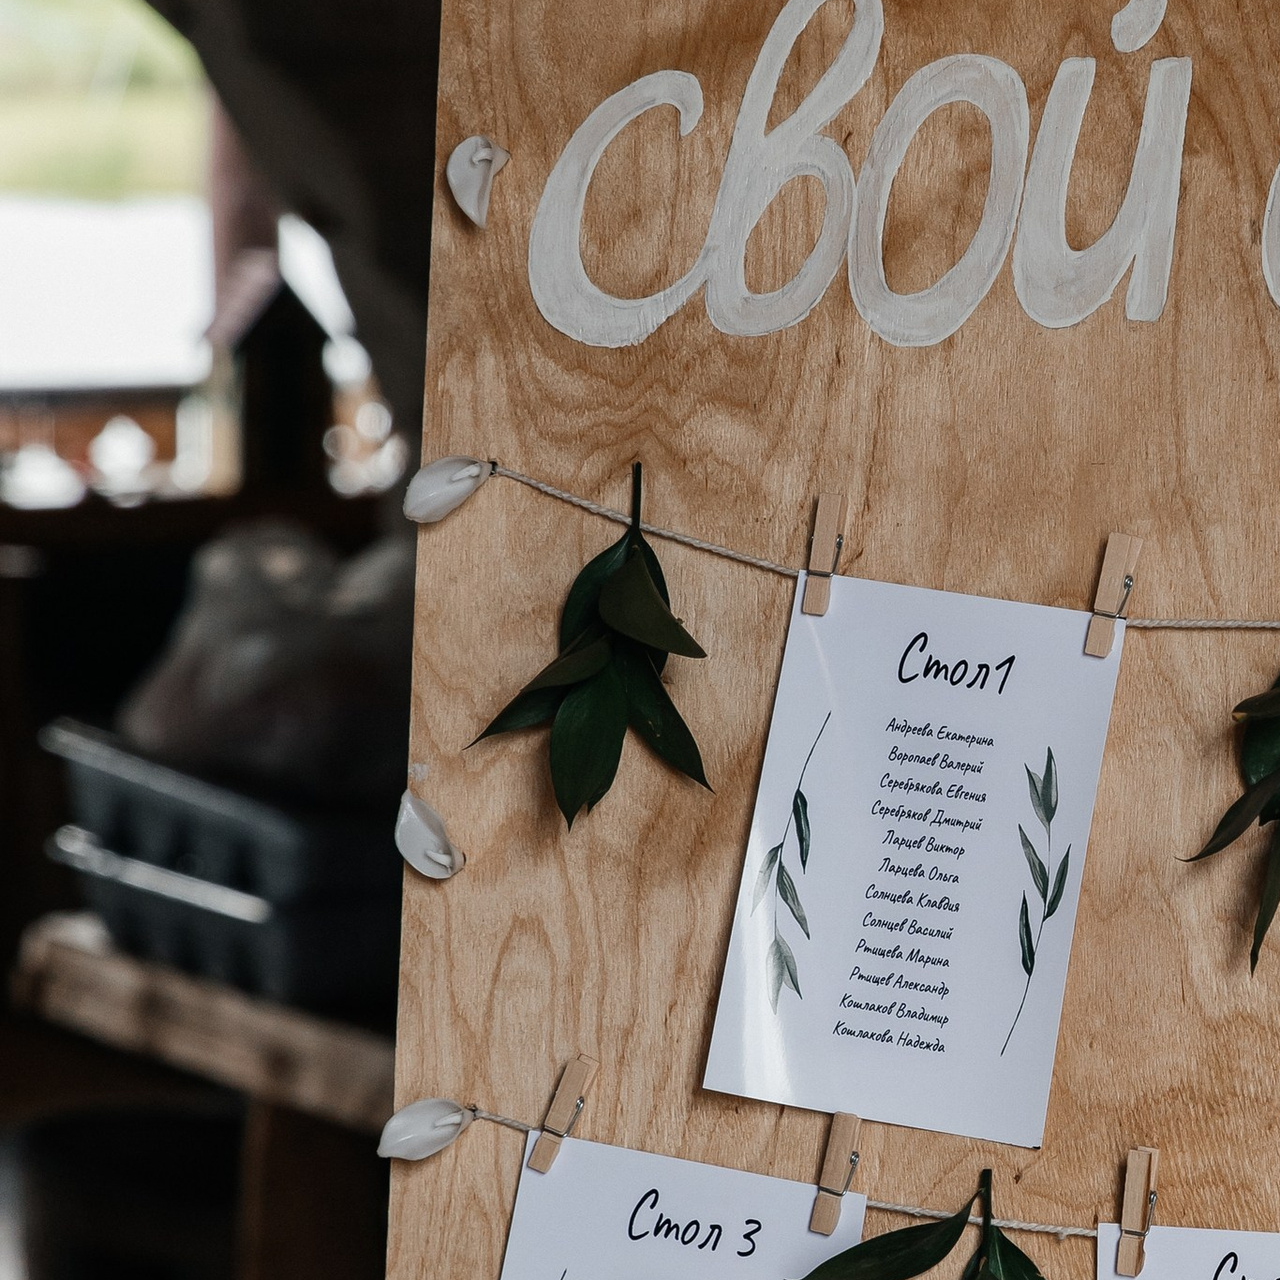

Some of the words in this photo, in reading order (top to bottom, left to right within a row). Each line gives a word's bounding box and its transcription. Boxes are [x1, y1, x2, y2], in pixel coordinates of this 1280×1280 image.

[885, 717, 934, 738] Андреева
[936, 725, 994, 748] Екатерина
[888, 745, 940, 767] Воропаев
[939, 753, 985, 776] Валерий
[880, 772, 943, 796] Серебрякова
[946, 784, 987, 803] Евгения
[871, 799, 932, 822] Серебряков
[929, 809, 983, 833] Дмитрий
[882, 829, 926, 851] Ларцев
[925, 836, 965, 860] Виктор
[878, 857, 925, 878] Ларцева
[928, 866, 959, 884] Ольга
[862, 911, 909, 933] Солнцев
[907, 919, 954, 940] Василий
[855, 938, 903, 959] Ртищева
[905, 948, 950, 969] Марина
[849, 966, 895, 986] Ртищев
[892, 974, 950, 1000] Александр
[839, 993, 897, 1015] Кошлаков
[895, 1002, 949, 1029] Владимир
[832, 1020, 894, 1043] Кошлакова
[896, 1031, 945, 1053] Надежда
[627, 1188, 723, 1252] Стол
[737, 1219, 762, 1257] 3
